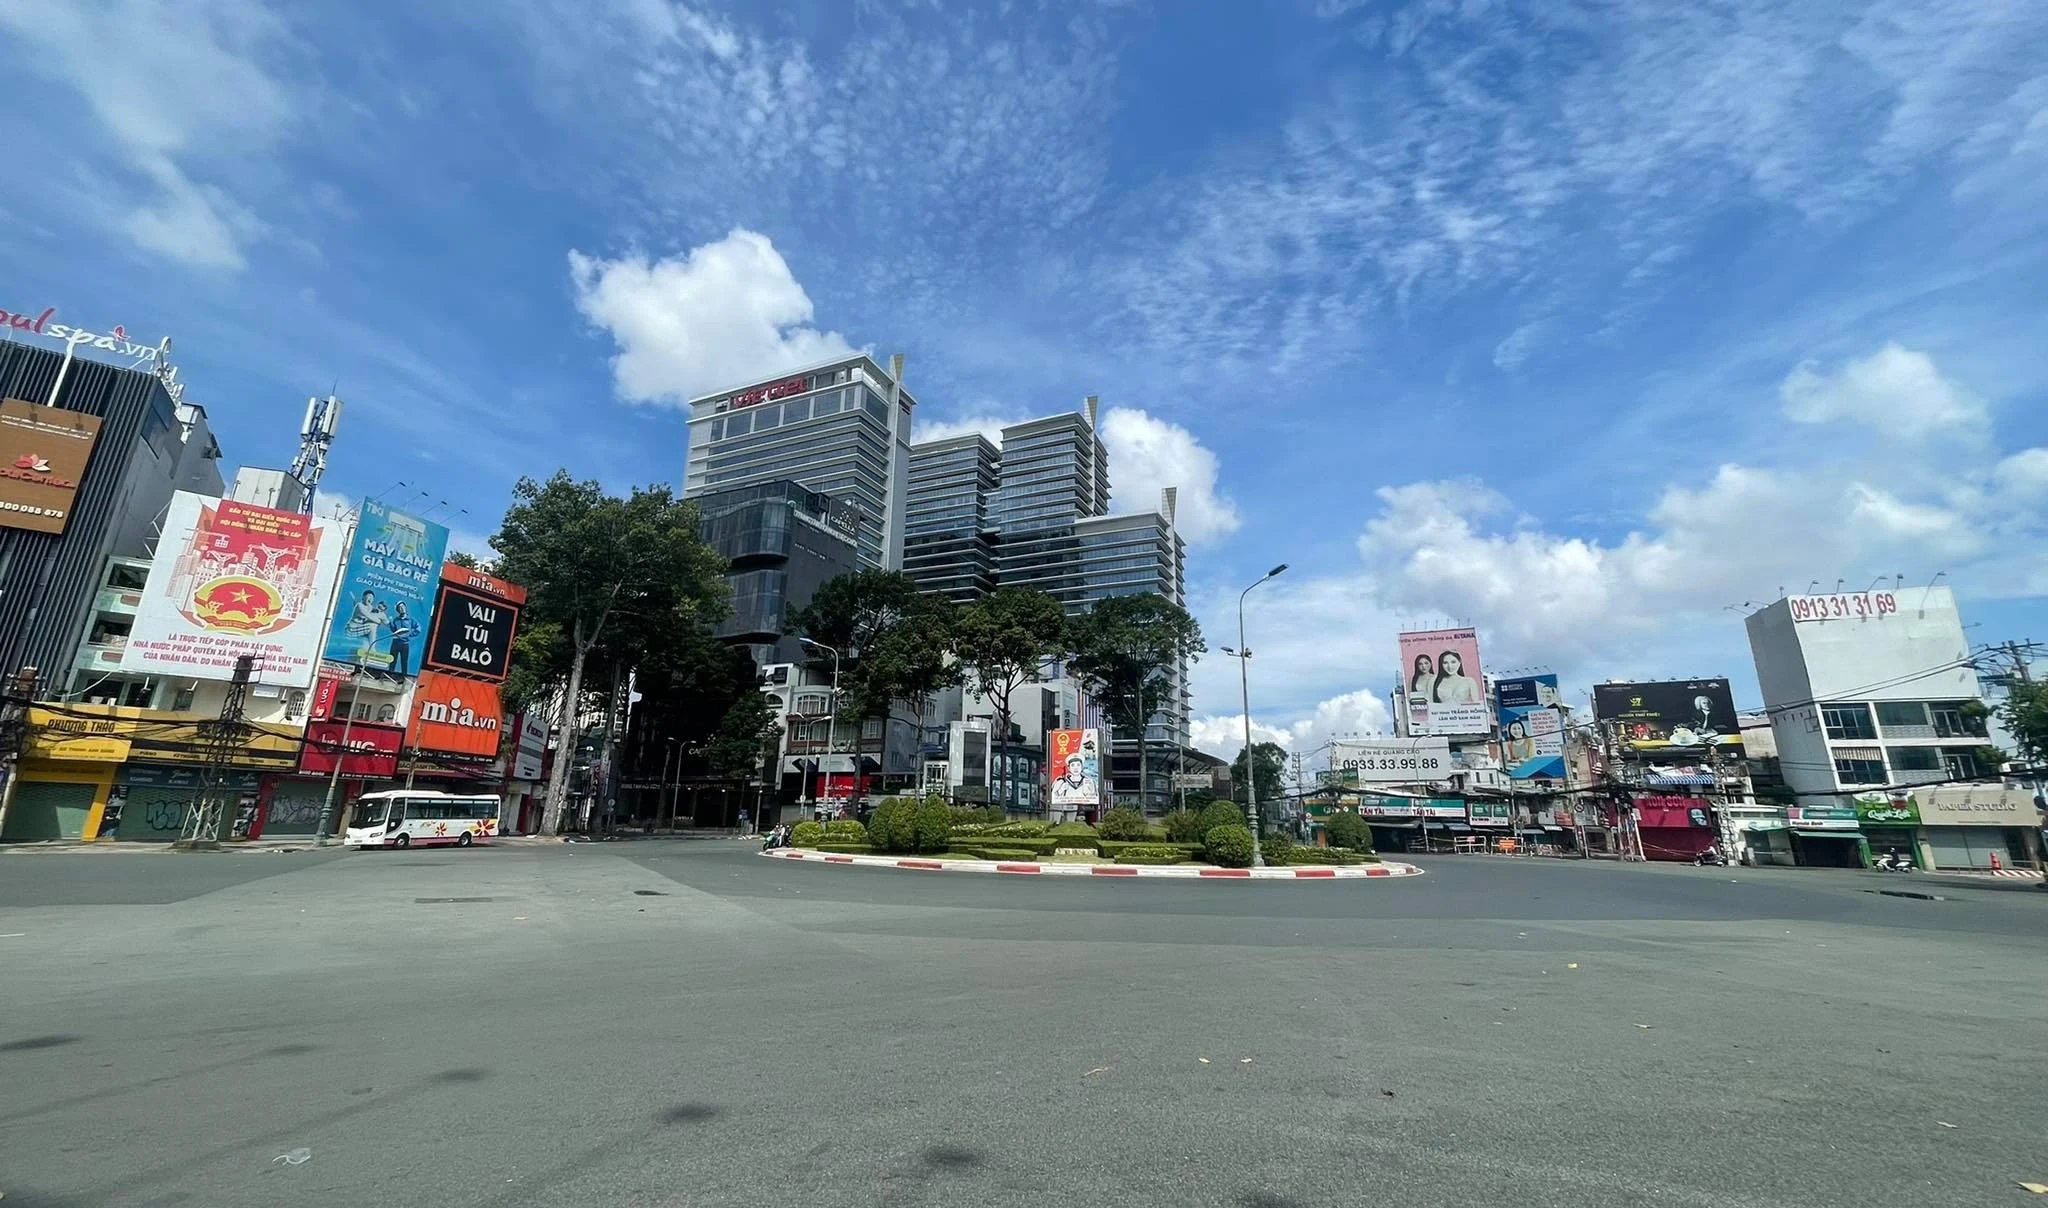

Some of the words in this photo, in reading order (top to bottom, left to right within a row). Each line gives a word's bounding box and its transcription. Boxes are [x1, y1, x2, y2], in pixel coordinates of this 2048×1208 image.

[362, 555, 384, 569] GIÁ
[365, 538, 395, 557] MÁY
[396, 550, 433, 570] LẠNH
[468, 576, 505, 595] mia.vn
[468, 602, 496, 623] VALI
[1791, 598, 1828, 619] 0913
[1830, 596, 1850, 616] 31
[1853, 595, 1872, 615] 31
[1876, 593, 1896, 613] 69
[179, 634, 197, 643] TRỰC
[199, 636, 214, 645] TIẾP
[215, 638, 229, 646] GÓP
[250, 642, 265, 650] XÂY
[464, 624, 489, 644] TÚI
[144, 650, 158, 660] CỦA
[160, 653, 180, 662] NHÂN
[211, 658, 230, 667] NHÂN
[171, 643, 192, 652] PHÁP
[193, 646, 216, 655] QUYỀN
[278, 655, 292, 663] VIỆT
[293, 657, 308, 665] NAM
[451, 644, 492, 666] BALÔ
[420, 698, 496, 729] mia.vn
